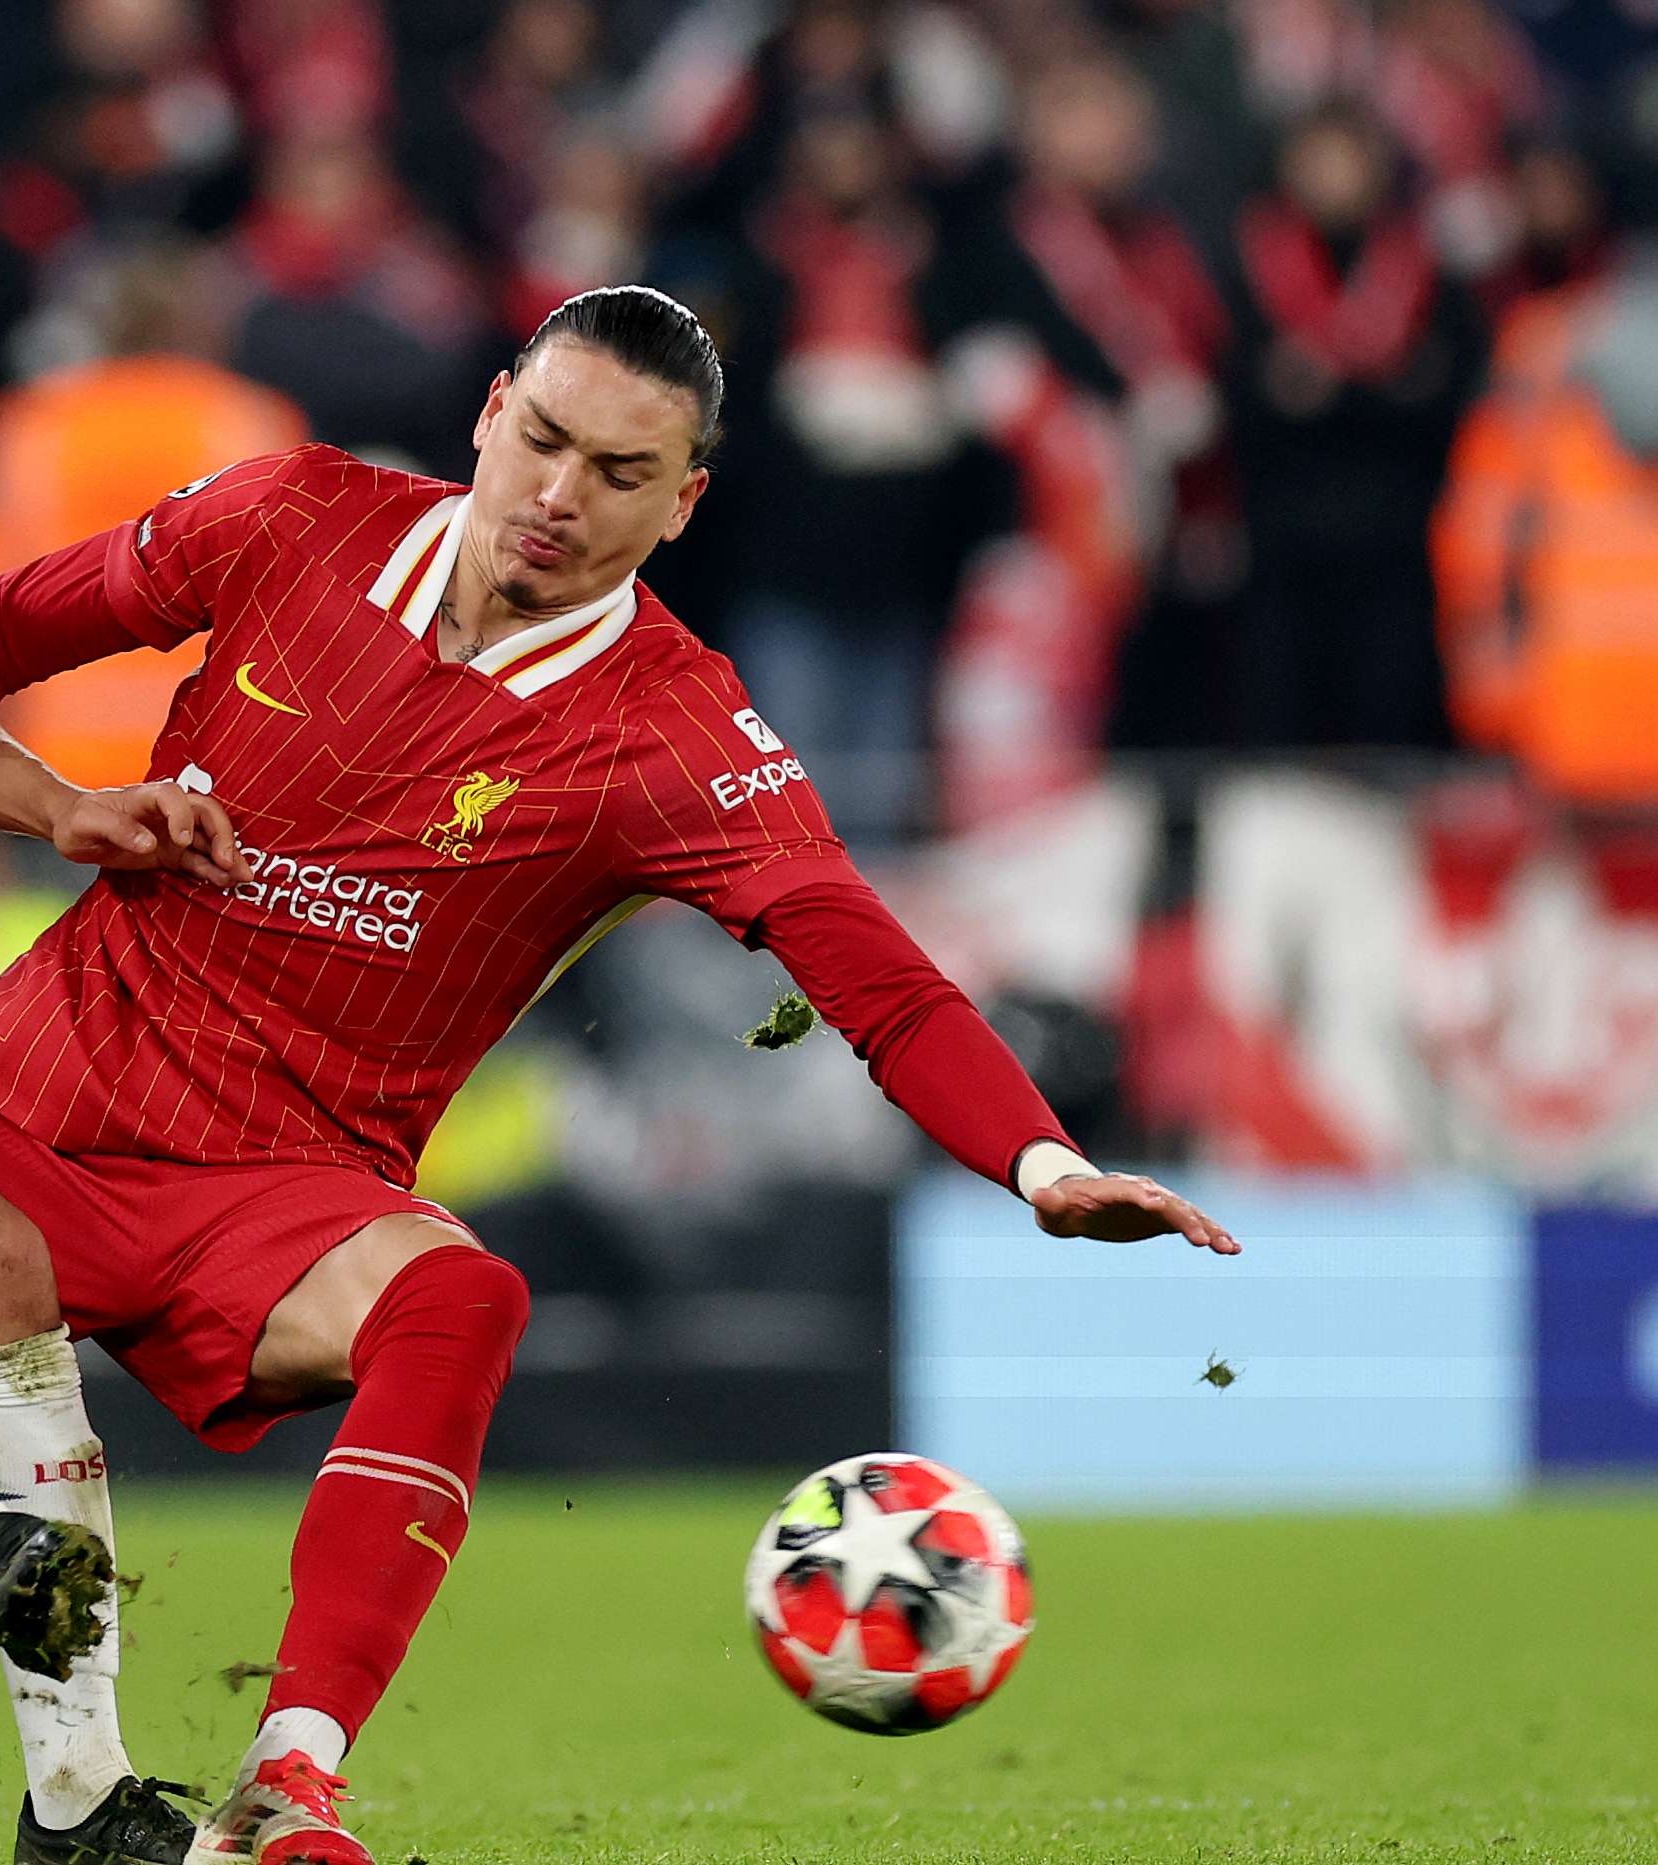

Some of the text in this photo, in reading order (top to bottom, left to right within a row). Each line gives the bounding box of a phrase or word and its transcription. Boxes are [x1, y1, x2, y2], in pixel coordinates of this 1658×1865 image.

[710, 757, 809, 811] Expe
[234, 831, 424, 920] andard
[221, 879, 422, 953] artered
[34, 1451, 104, 1485] LOS
